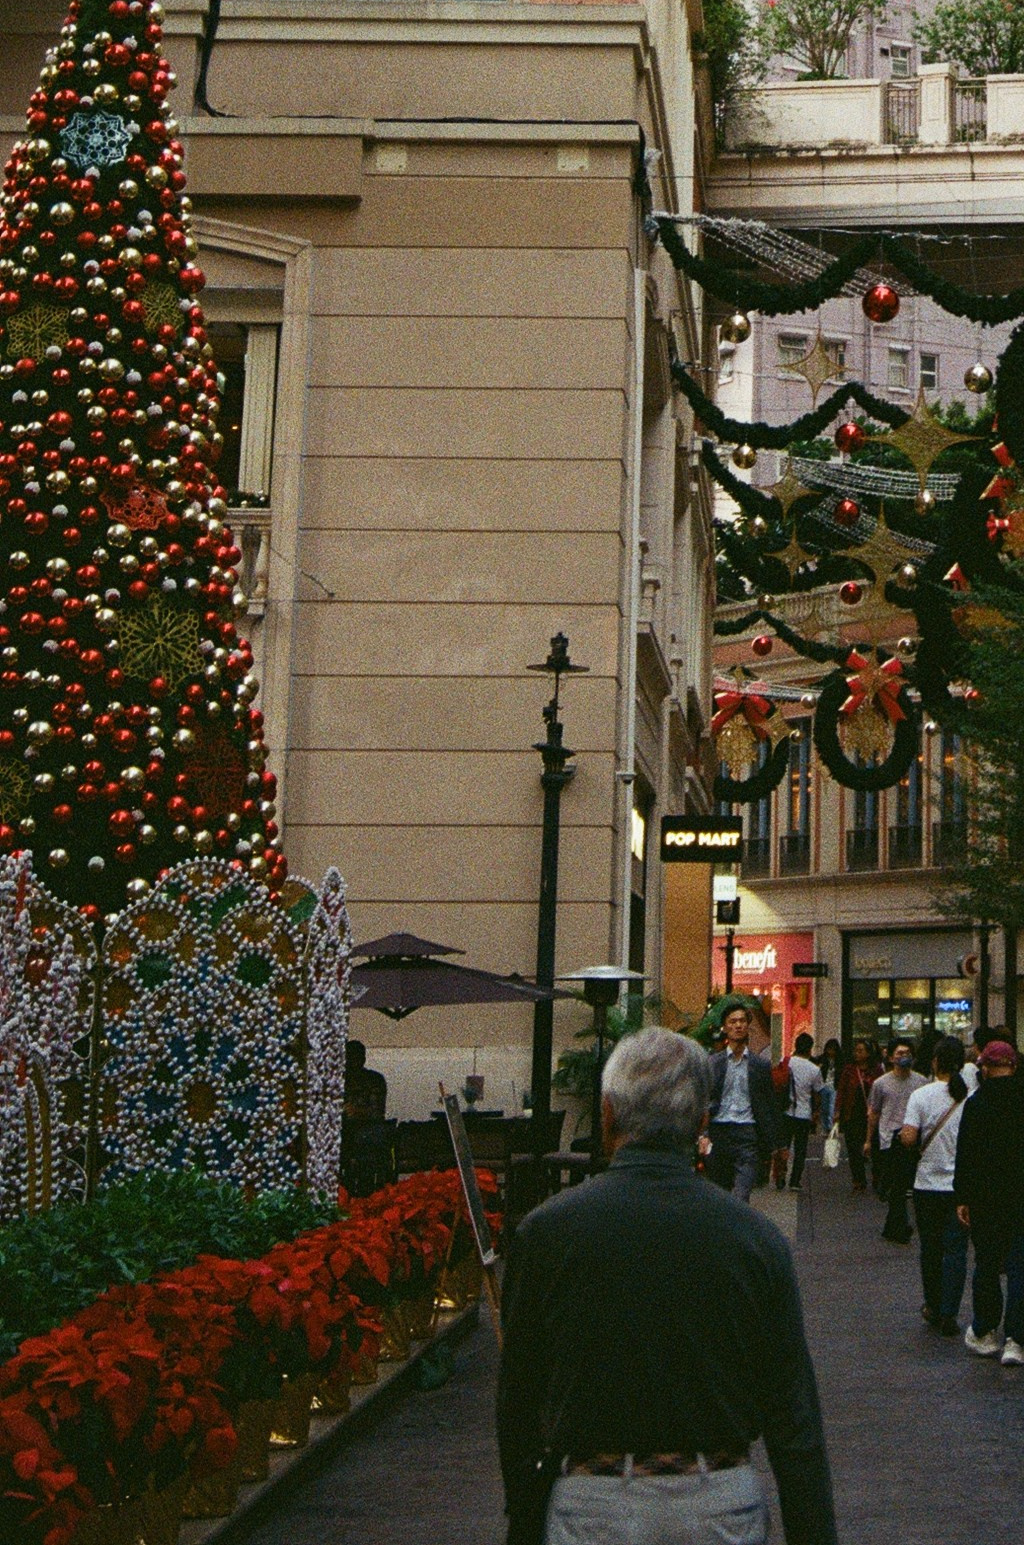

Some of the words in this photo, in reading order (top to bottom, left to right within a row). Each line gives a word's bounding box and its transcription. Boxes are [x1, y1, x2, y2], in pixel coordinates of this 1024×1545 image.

[666, 832, 695, 846] POP
[699, 832, 739, 846] MART
[733, 944, 777, 974] benefit
